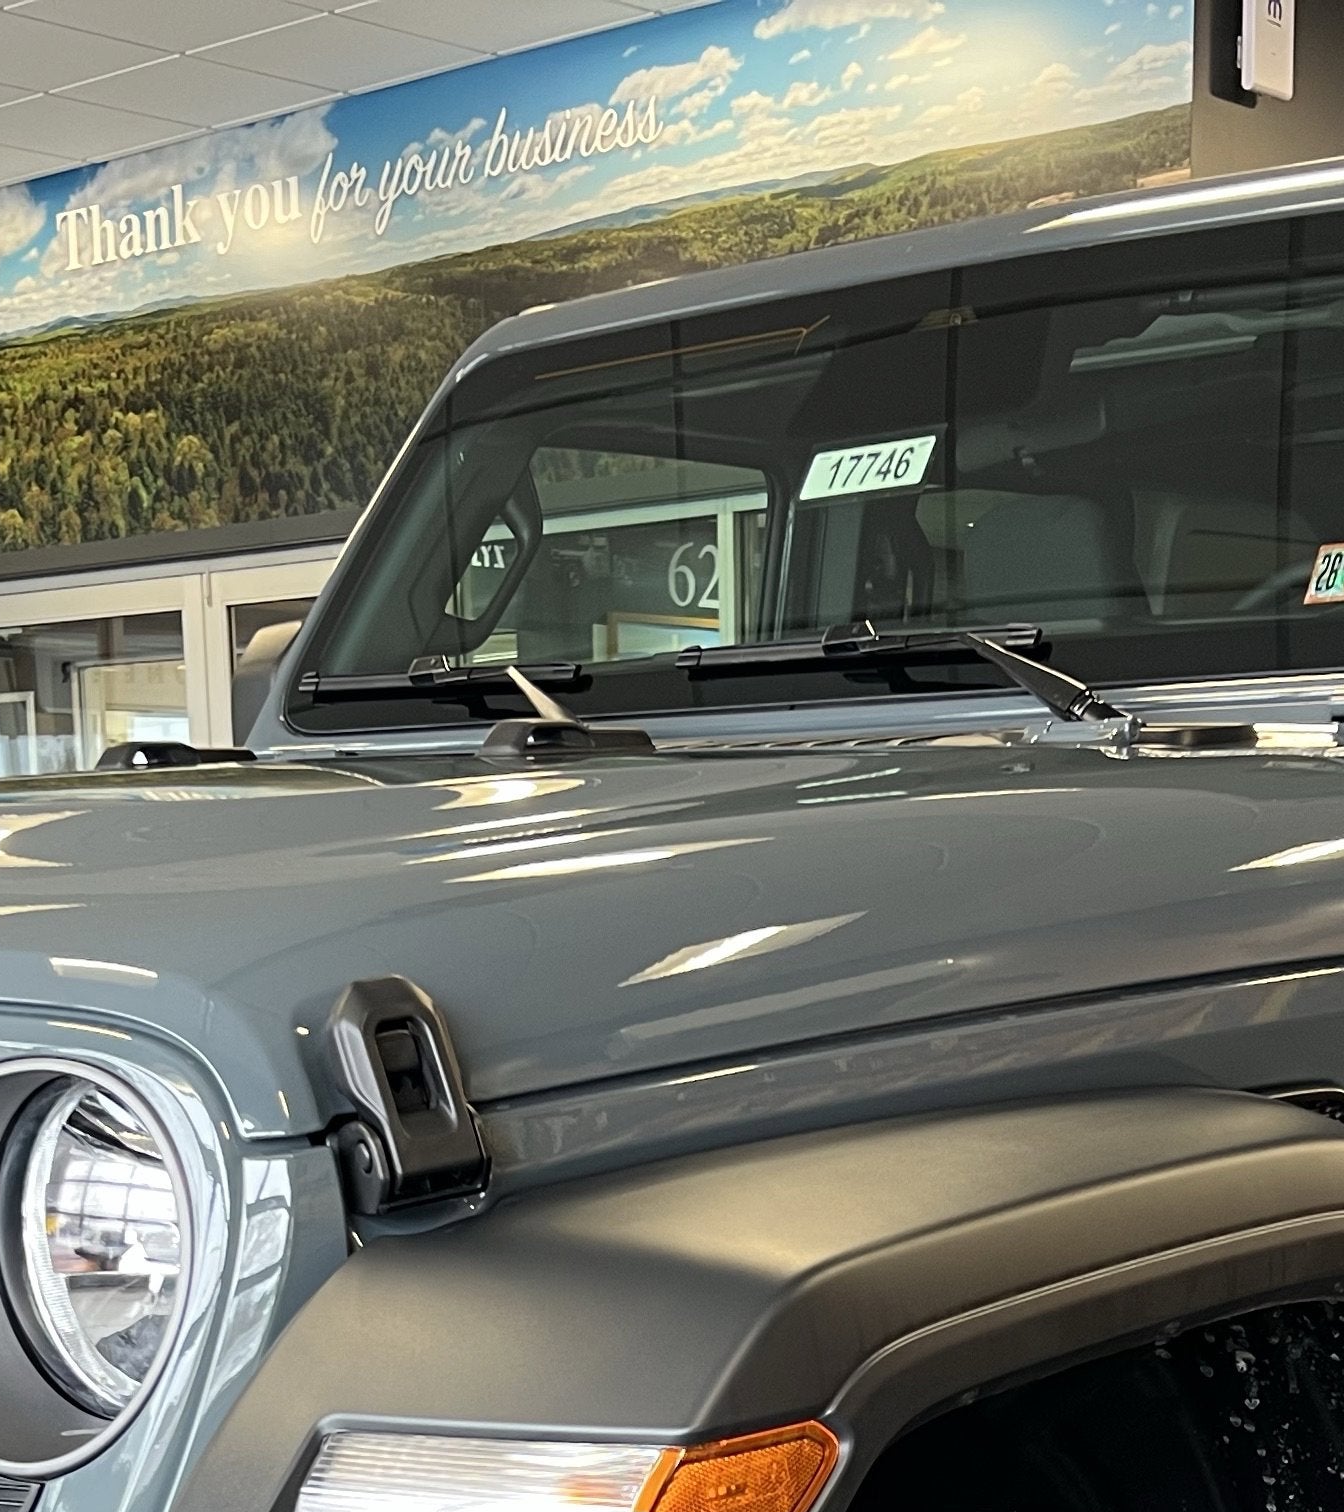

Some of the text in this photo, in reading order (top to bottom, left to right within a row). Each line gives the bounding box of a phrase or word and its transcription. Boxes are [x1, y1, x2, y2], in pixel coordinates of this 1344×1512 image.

[56, 94, 664, 272] Thank you for your business
[829, 447, 915, 490] 17746
